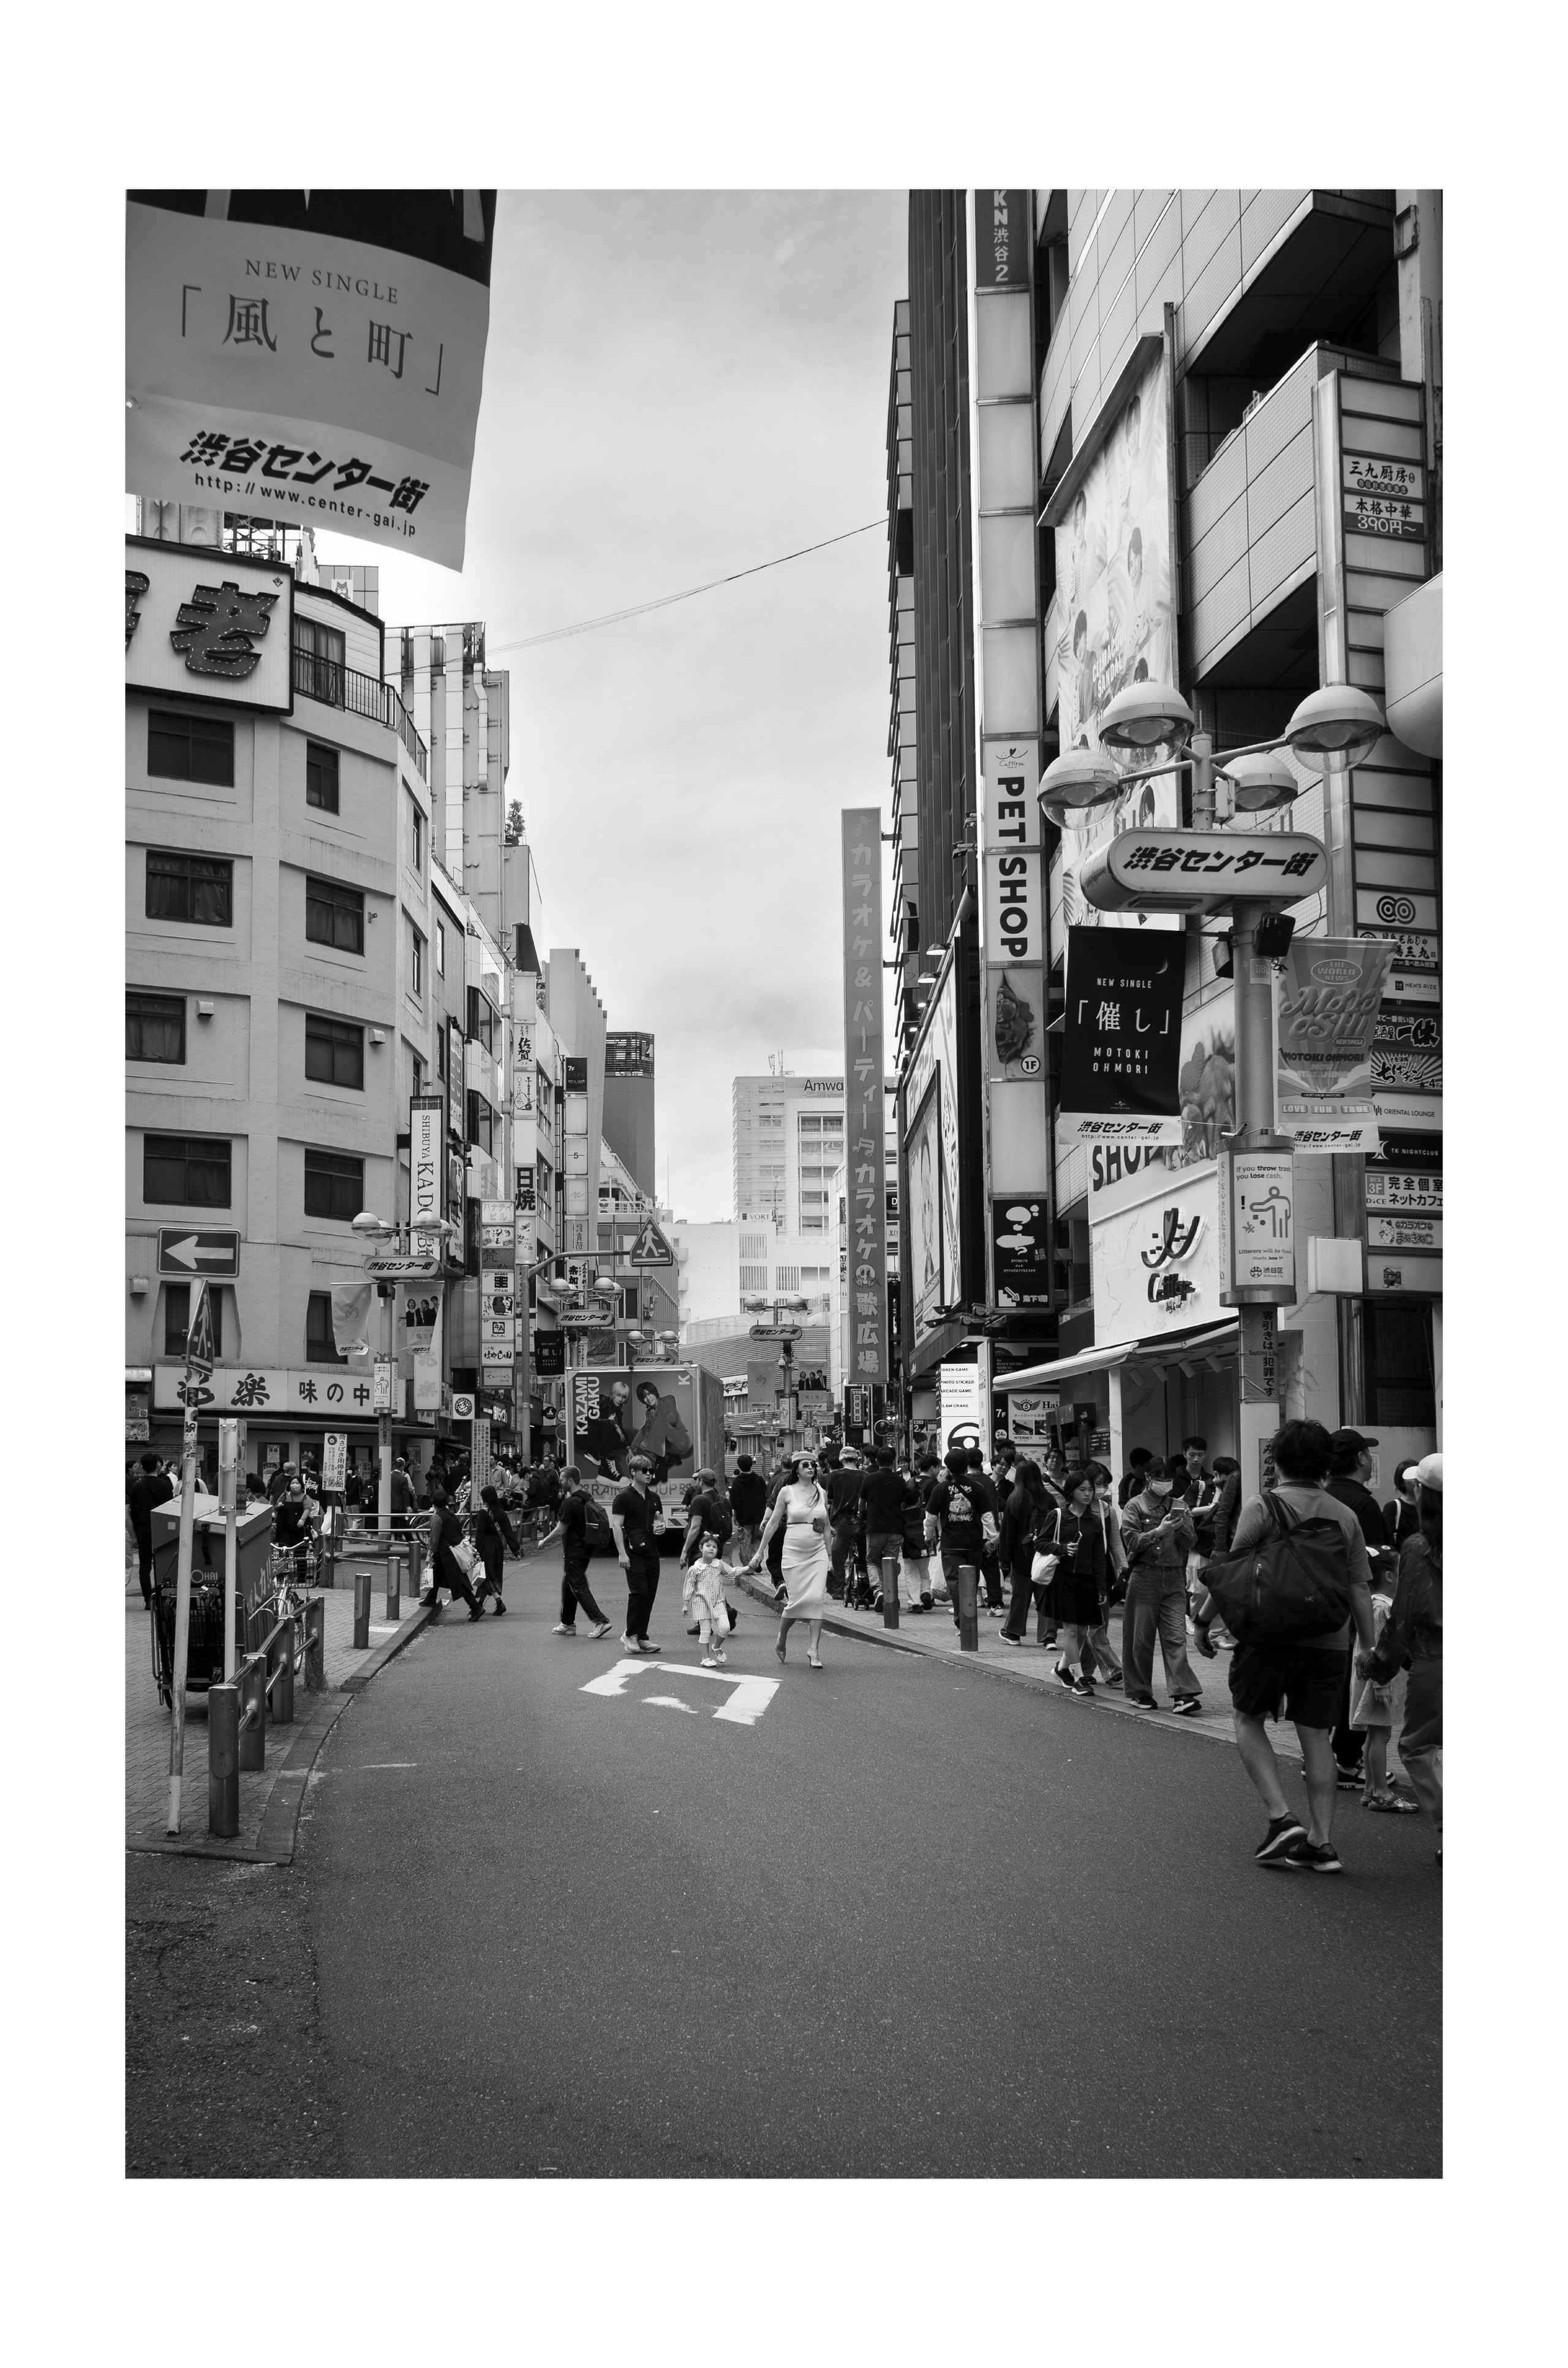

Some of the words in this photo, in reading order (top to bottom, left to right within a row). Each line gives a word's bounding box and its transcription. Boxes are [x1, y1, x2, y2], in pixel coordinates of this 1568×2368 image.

[244, 259, 302, 282] NEW
[311, 270, 399, 305] SINGLE
[182, 284, 443, 395] 「風と町」
[179, 430, 431, 515] 渋谷センター街
[1349, 461, 1408, 483] 三九厨房
[194, 472, 417, 537] http://www.center-gai.jp
[1355, 497, 1412, 520] 本格中華
[126, 570, 281, 678] 老
[1098, 653, 1123, 698] SANDAL
[998, 776, 1026, 843] PET
[1122, 845, 1319, 876] 渋谷センター街
[998, 857, 1028, 958] SHOP
[1097, 978, 1115, 987] NEW
[1120, 979, 1152, 989] SINGLE
[1078, 1000, 1169, 1034] 「催し」
[518, 1037, 533, 1062] 佐賀
[1024, 1060, 1037, 1070] 1F
[1094, 1047, 1148, 1059] MOTOKI
[1325, 1053, 1365, 1062] OHMORI
[1093, 1062, 1148, 1075] OHMORI
[804, 1079, 844, 1092] Amwa
[422, 1115, 431, 1159] SHIBUYA
[1077, 1121, 1163, 1134] 渋谷センター街
[1294, 1130, 1363, 1141] 渋谷センター街
[516, 1168, 536, 1211] 日焼
[1369, 1183, 1382, 1193] 3F
[1389, 1176, 1442, 1192] 完全個室
[854, 1163, 878, 1261] カラオケ
[368, 1262, 434, 1271] 渋谷センター街
[856, 1291, 880, 1374] 歌広場
[576, 1377, 588, 1435] KAZAMI
[588, 1376, 600, 1420] GAKU
[995, 1409, 1006, 1418] 7F
[1262, 1443, 1276, 1493] 井の頭通
